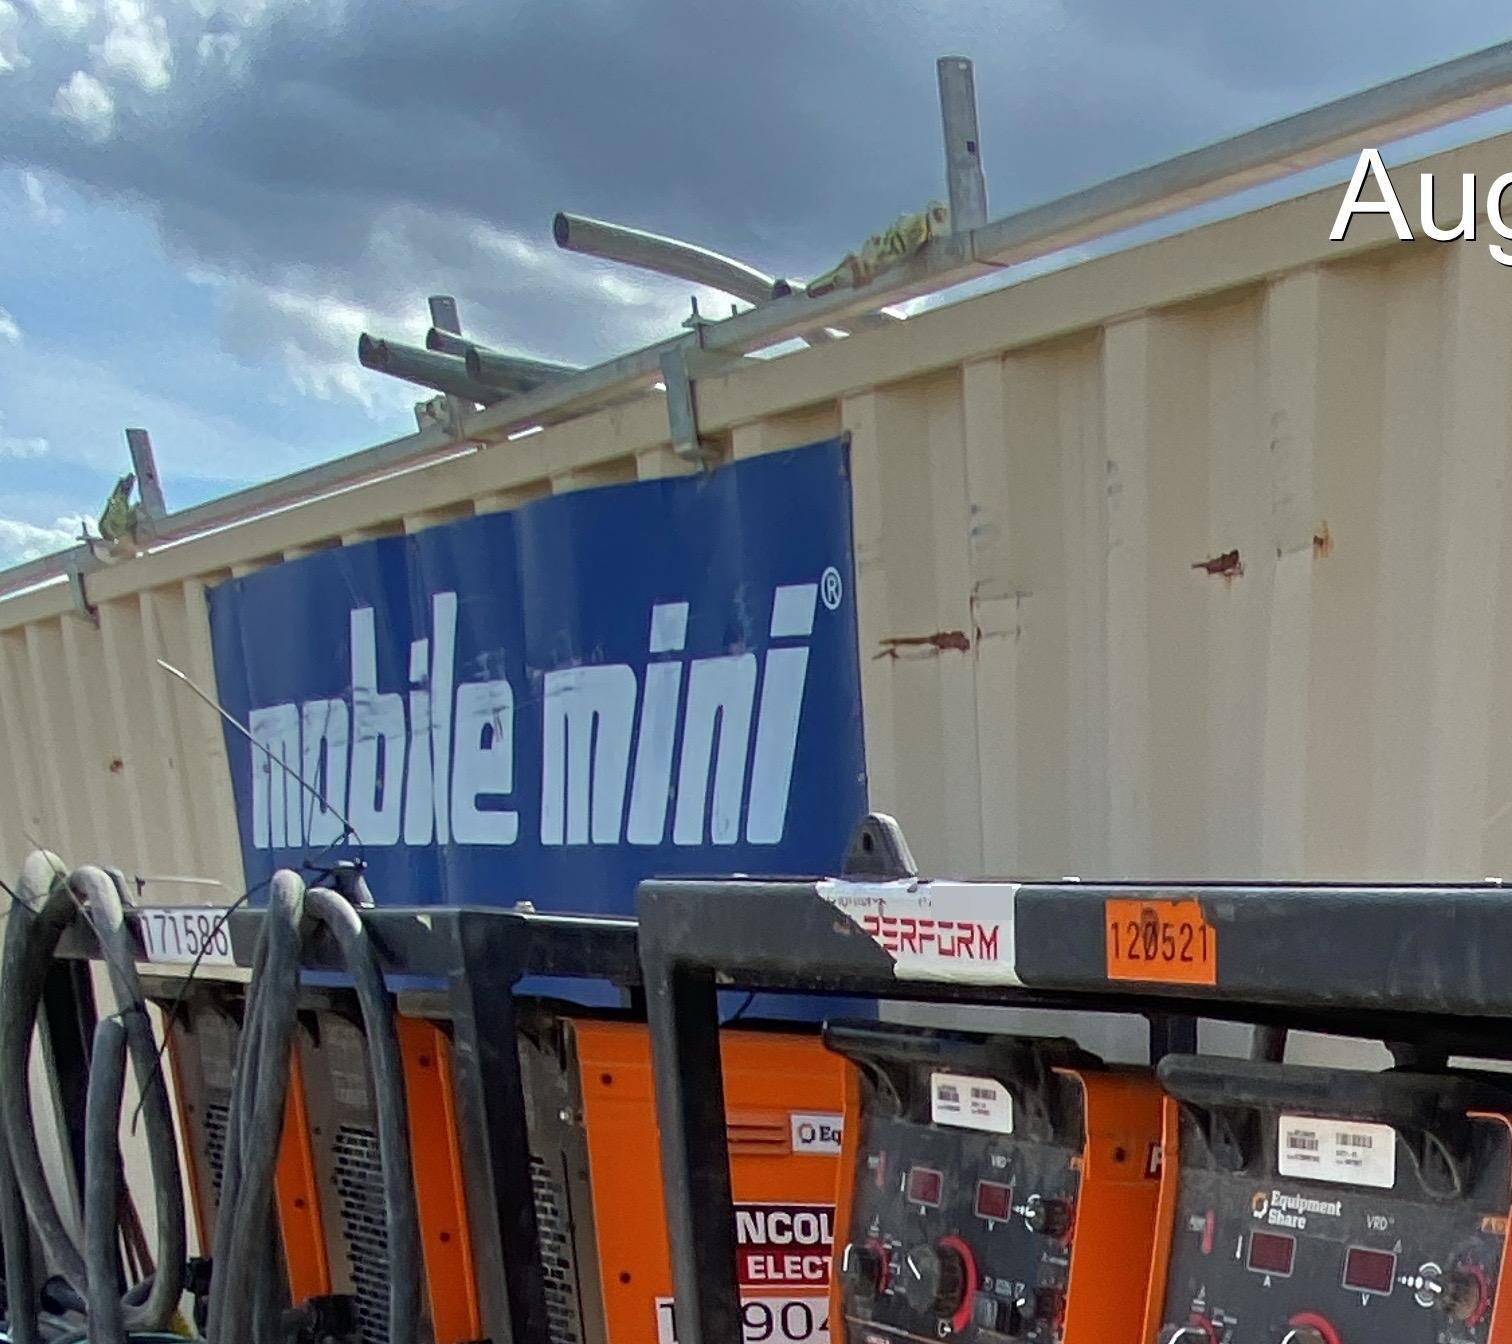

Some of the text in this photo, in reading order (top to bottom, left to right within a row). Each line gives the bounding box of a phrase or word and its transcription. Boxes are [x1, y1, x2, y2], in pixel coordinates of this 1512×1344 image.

[249, 583, 818, 848] mobile mini
[141, 914, 229, 956] 171586
[1110, 921, 1211, 963] 120521
[1268, 1209, 1307, 1230] Share
[1271, 1189, 1343, 1217] Equipment
[747, 1254, 832, 1281] ELECT
